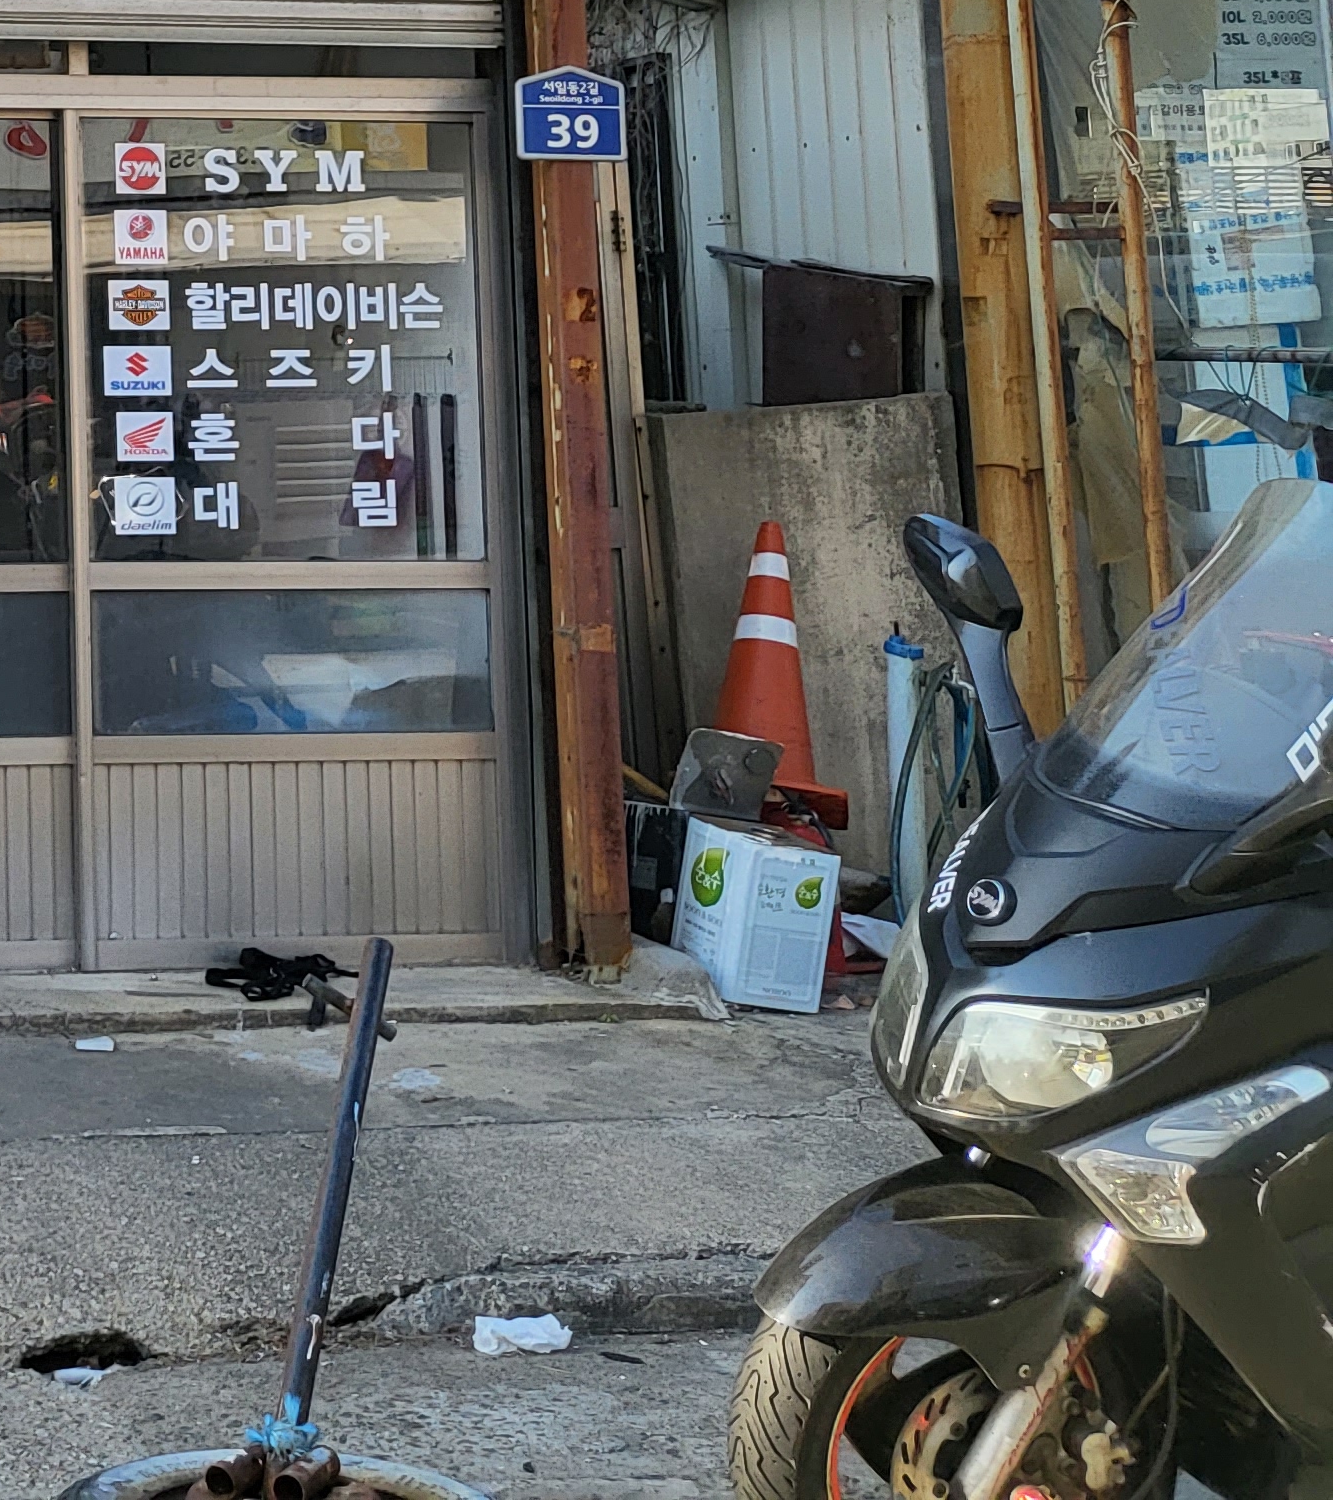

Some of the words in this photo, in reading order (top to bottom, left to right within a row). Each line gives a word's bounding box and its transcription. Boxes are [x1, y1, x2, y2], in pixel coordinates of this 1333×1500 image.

[542, 81, 599, 95] 서일동2길
[546, 113, 600, 149] 39
[119, 159, 162, 182] SYM
[203, 148, 367, 194] SYM
[118, 247, 165, 260] YAMAHA
[184, 282, 444, 330] 할리데이비슨
[110, 380, 166, 391] SUZUKI
[124, 448, 169, 456] HONDA
[121, 519, 173, 531] daelim
